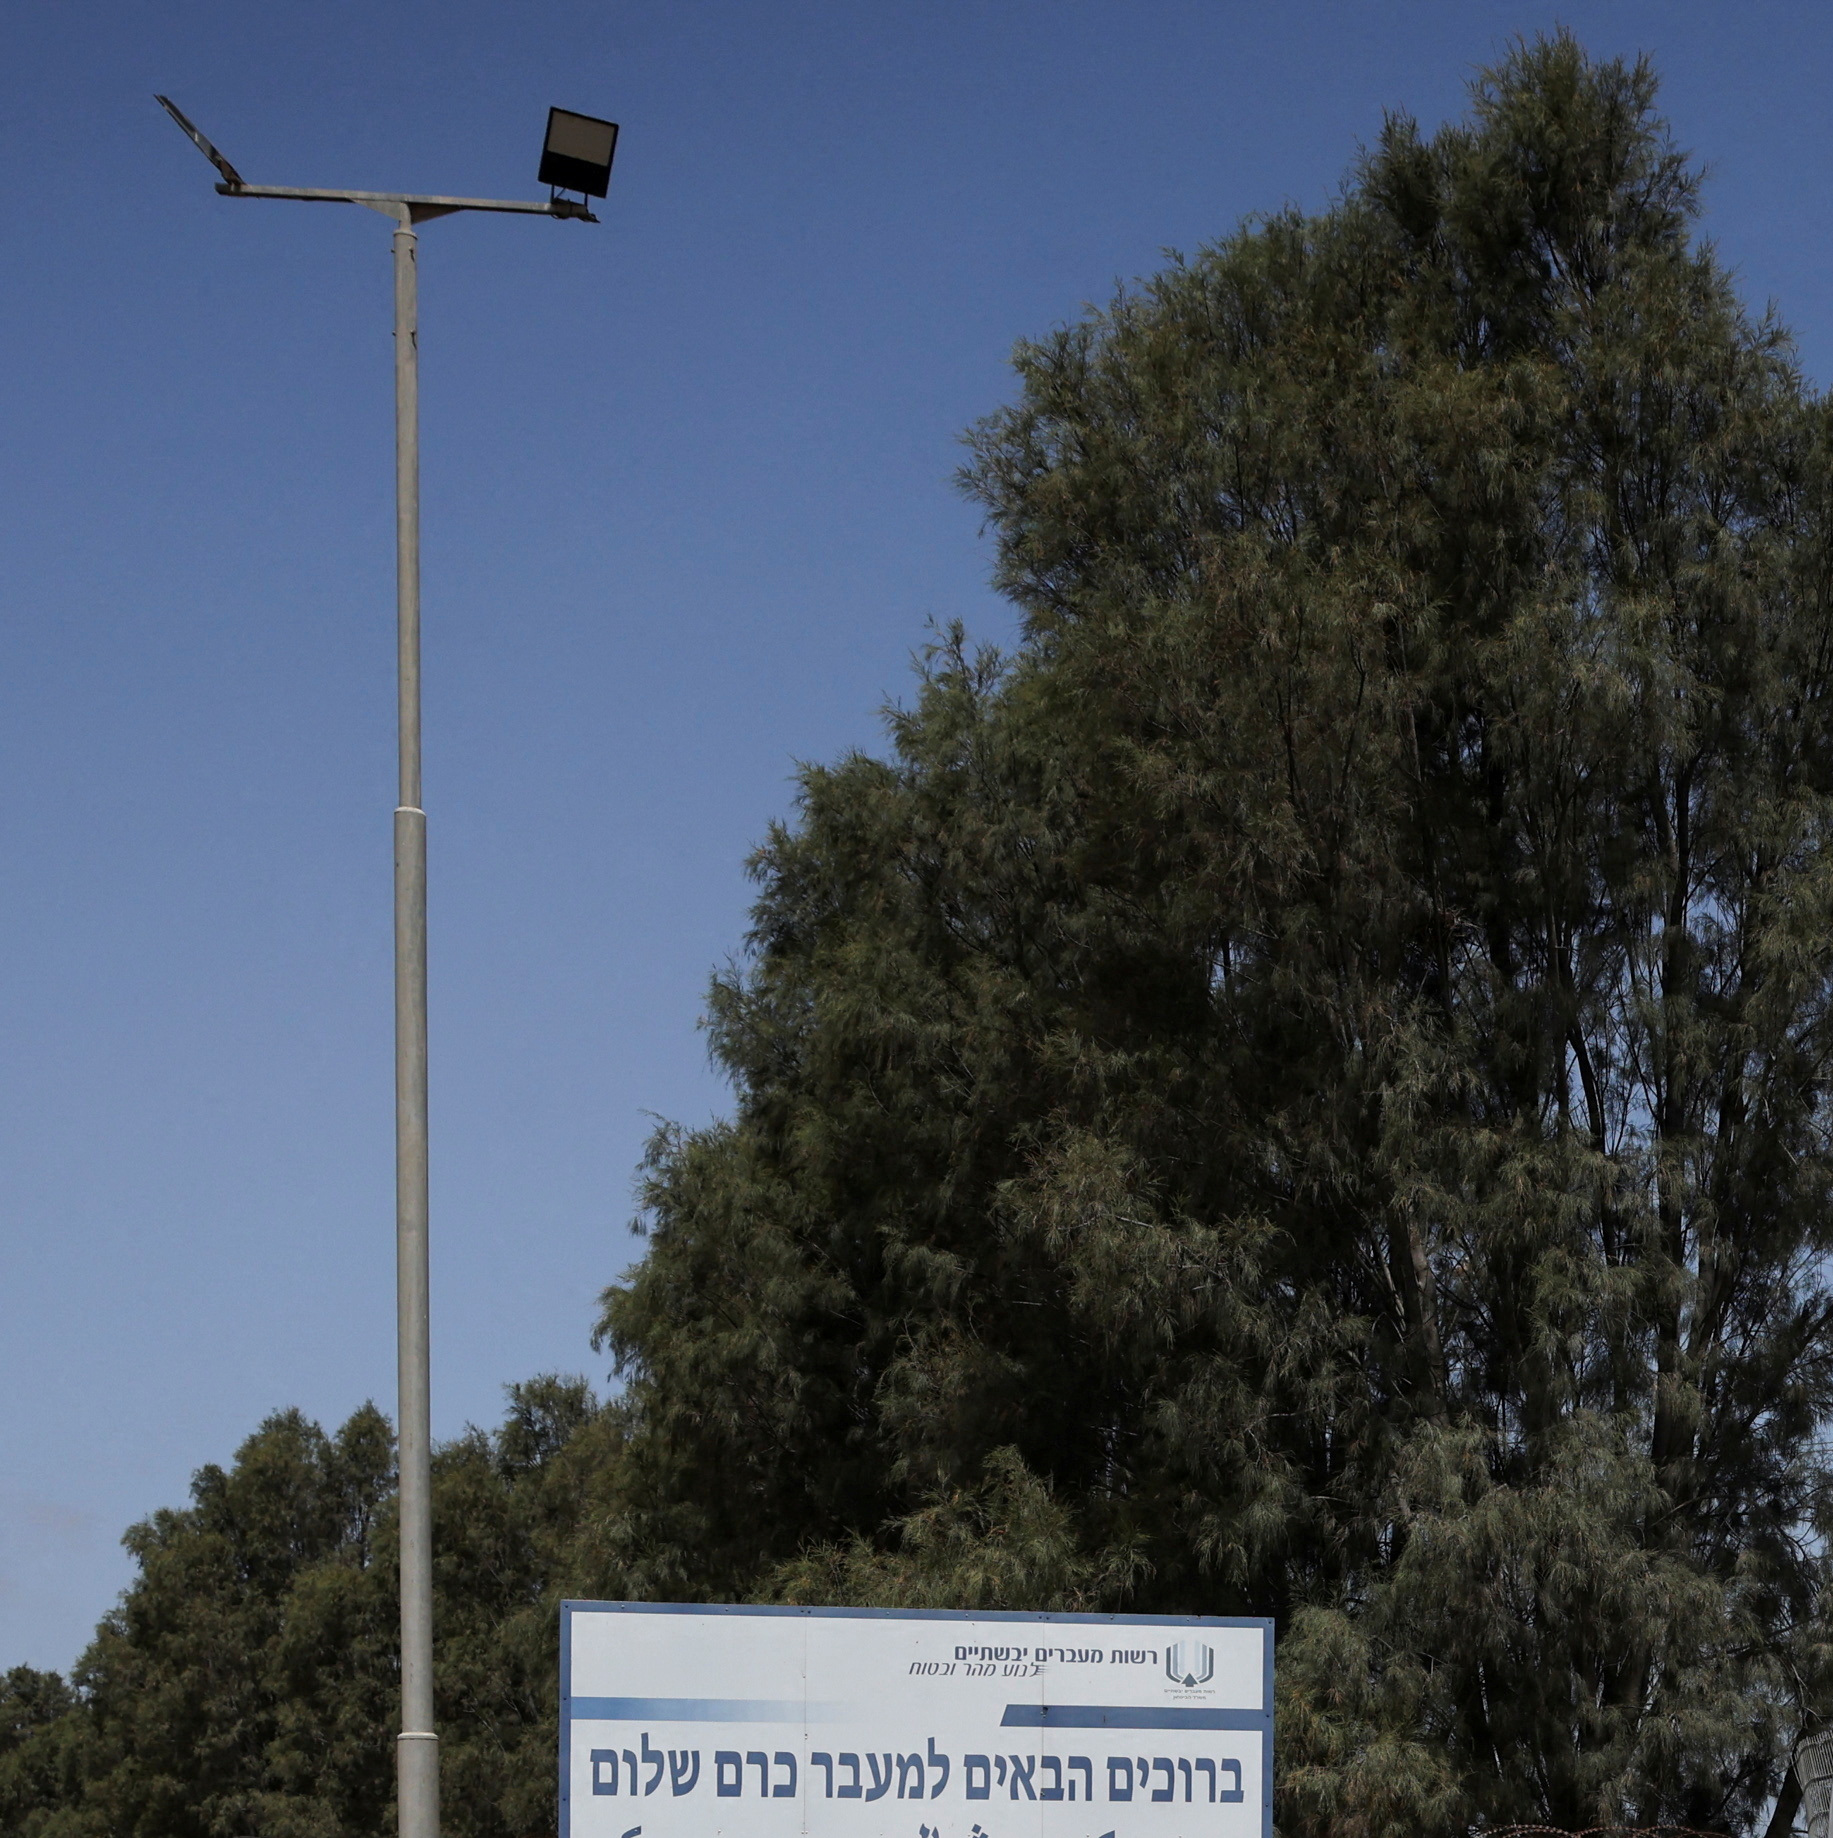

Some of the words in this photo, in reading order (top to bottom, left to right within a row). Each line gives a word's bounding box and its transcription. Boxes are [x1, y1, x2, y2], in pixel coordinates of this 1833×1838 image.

[954, 1646, 1028, 1662] יבשתיים
[1035, 1647, 1104, 1664] מעברים
[1109, 1650, 1158, 1665] רשות
[908, 1661, 957, 1676] ובטוח
[963, 1663, 997, 1677] מהר
[1001, 1662, 1044, 1678] לנוע
[589, 1732, 700, 1797] שלום
[811, 1736, 950, 1803] למעבר
[714, 1750, 798, 1798] כרם
[963, 1753, 1093, 1801] הבאים
[1107, 1756, 1245, 1803] ברוכים
